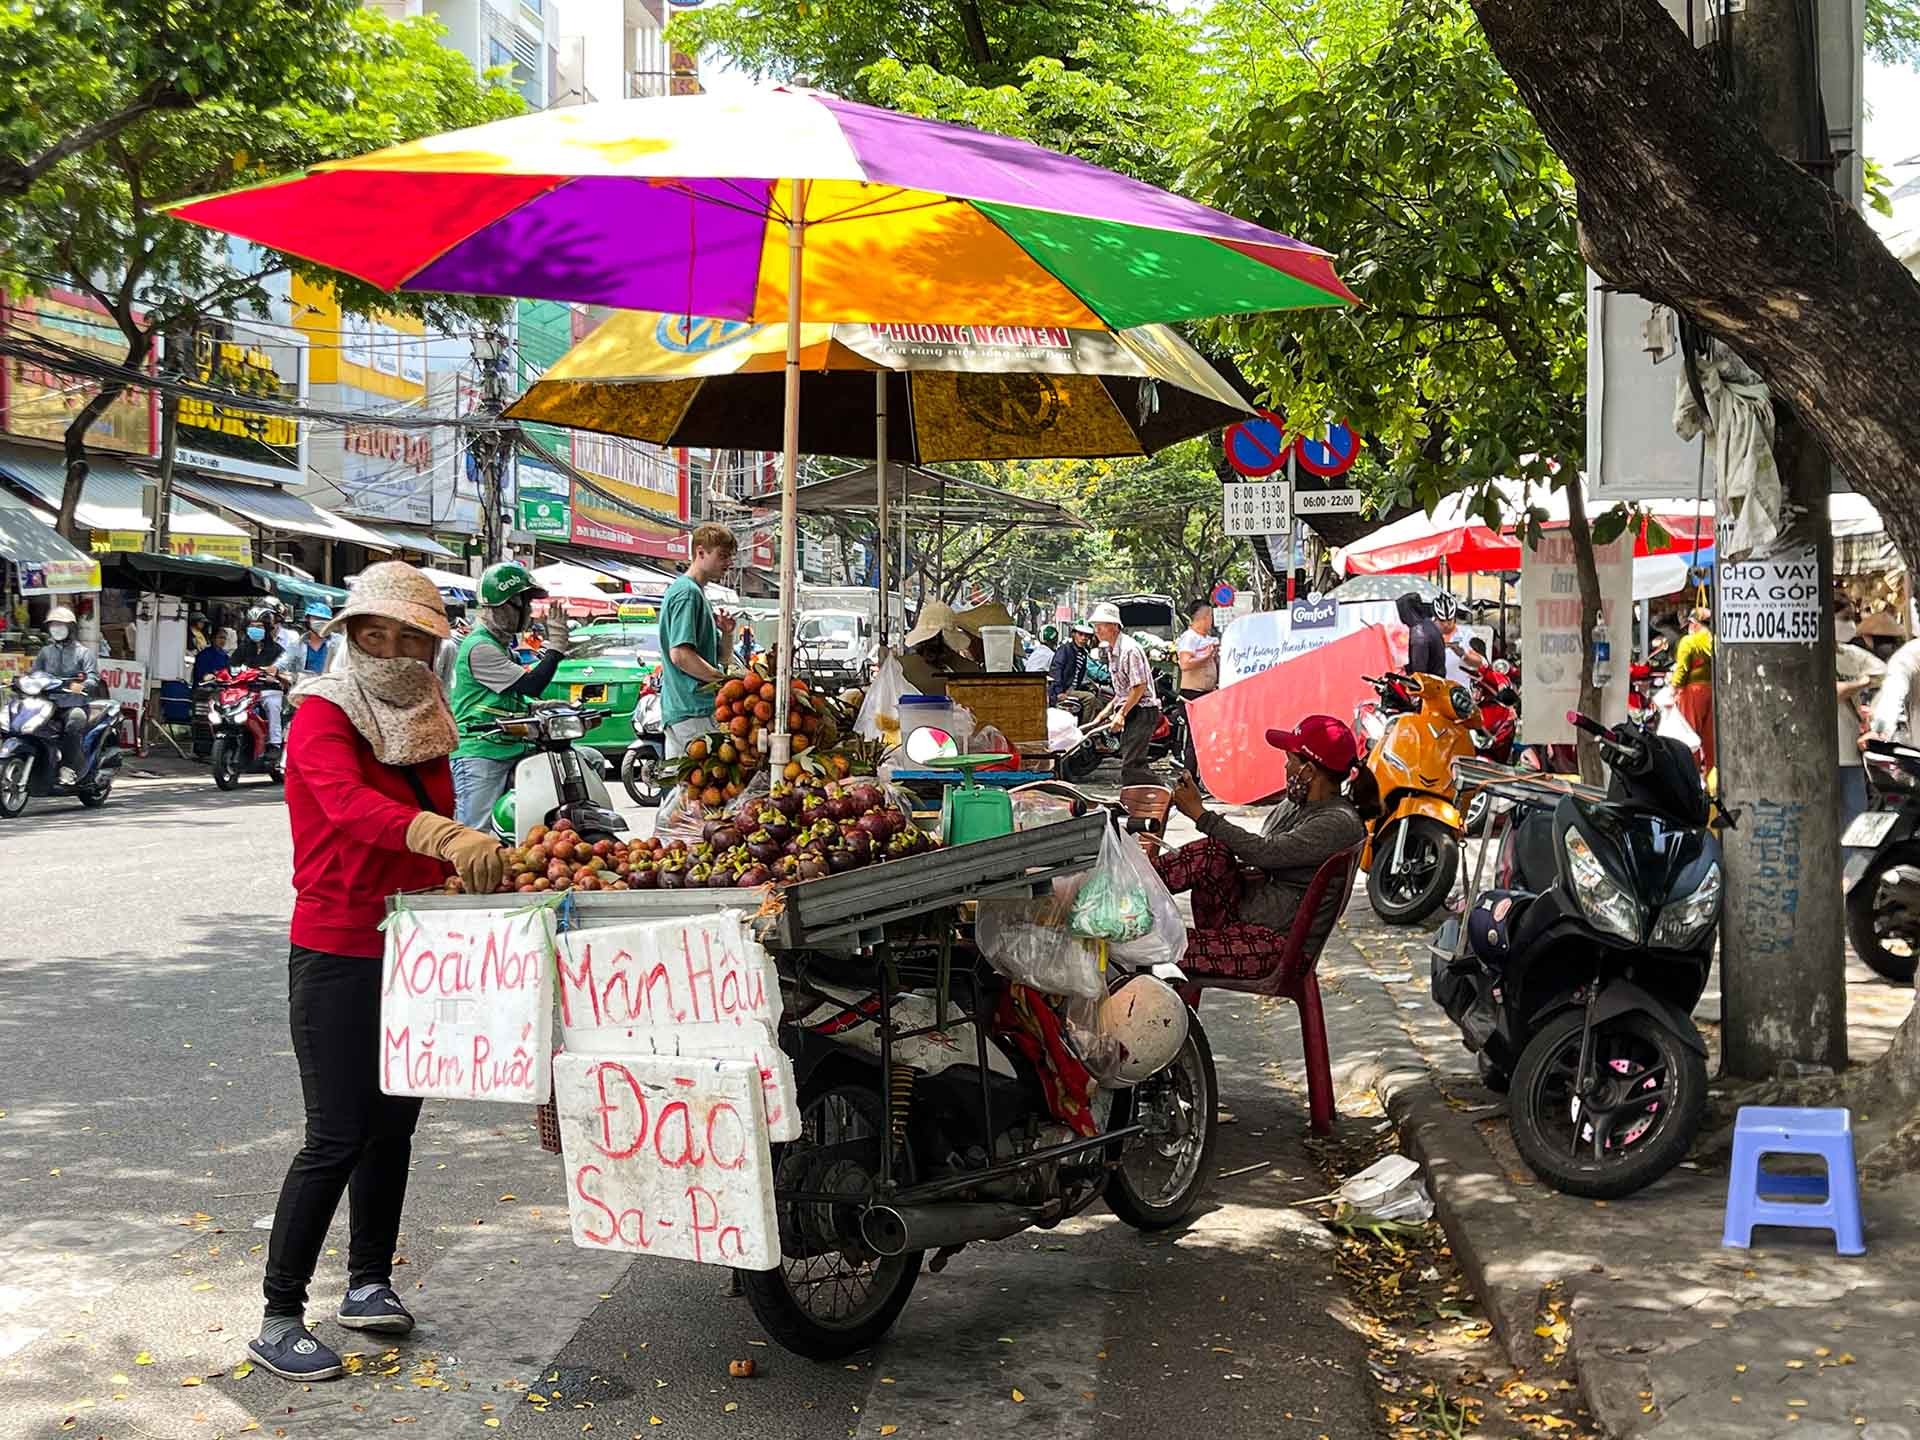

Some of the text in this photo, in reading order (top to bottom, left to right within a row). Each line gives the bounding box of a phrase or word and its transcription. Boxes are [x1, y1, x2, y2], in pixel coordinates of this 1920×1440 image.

[1233, 486, 1253, 499] 6:00
[1261, 485, 1281, 498] 8:30
[1231, 502, 1253, 514] 11:00
[1262, 501, 1285, 513] 13:30
[1263, 516, 1286, 529] 19:00
[1722, 565, 1815, 580] CHO VAY
[498, 575, 521, 591] Grab
[1722, 583, 1817, 600] TRẢ GÓP
[1293, 605, 1335, 623] Comfort
[1722, 611, 1817, 638] 0773.004.555
[126, 672, 142, 689] XE
[385, 921, 541, 998] Xoài Non
[682, 928, 766, 1025] Hậu
[384, 1022, 464, 1090] Mắm
[586, 1061, 746, 1169] Đào
